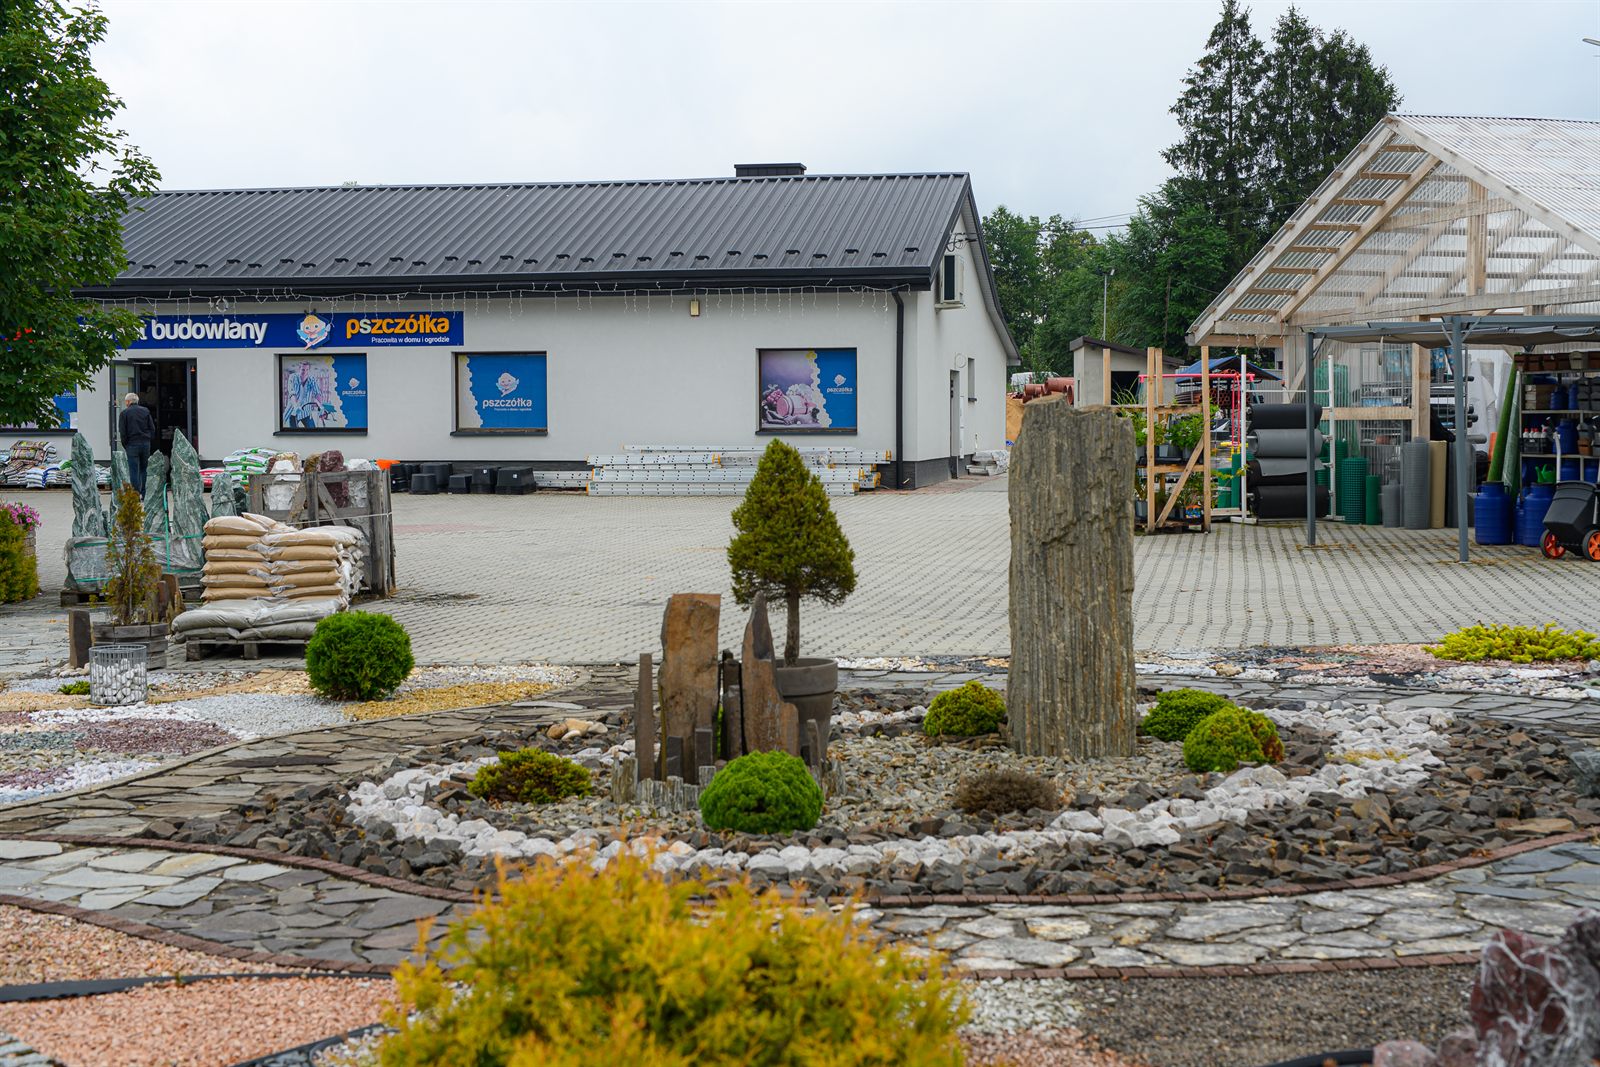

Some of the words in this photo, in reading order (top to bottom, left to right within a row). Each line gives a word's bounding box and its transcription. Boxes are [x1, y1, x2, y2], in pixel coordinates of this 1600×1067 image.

[151, 318, 268, 345] budowlany
[346, 314, 449, 338] pszczółka
[424, 336, 450, 344] ogrodzie
[482, 397, 533, 409] pszczółka
